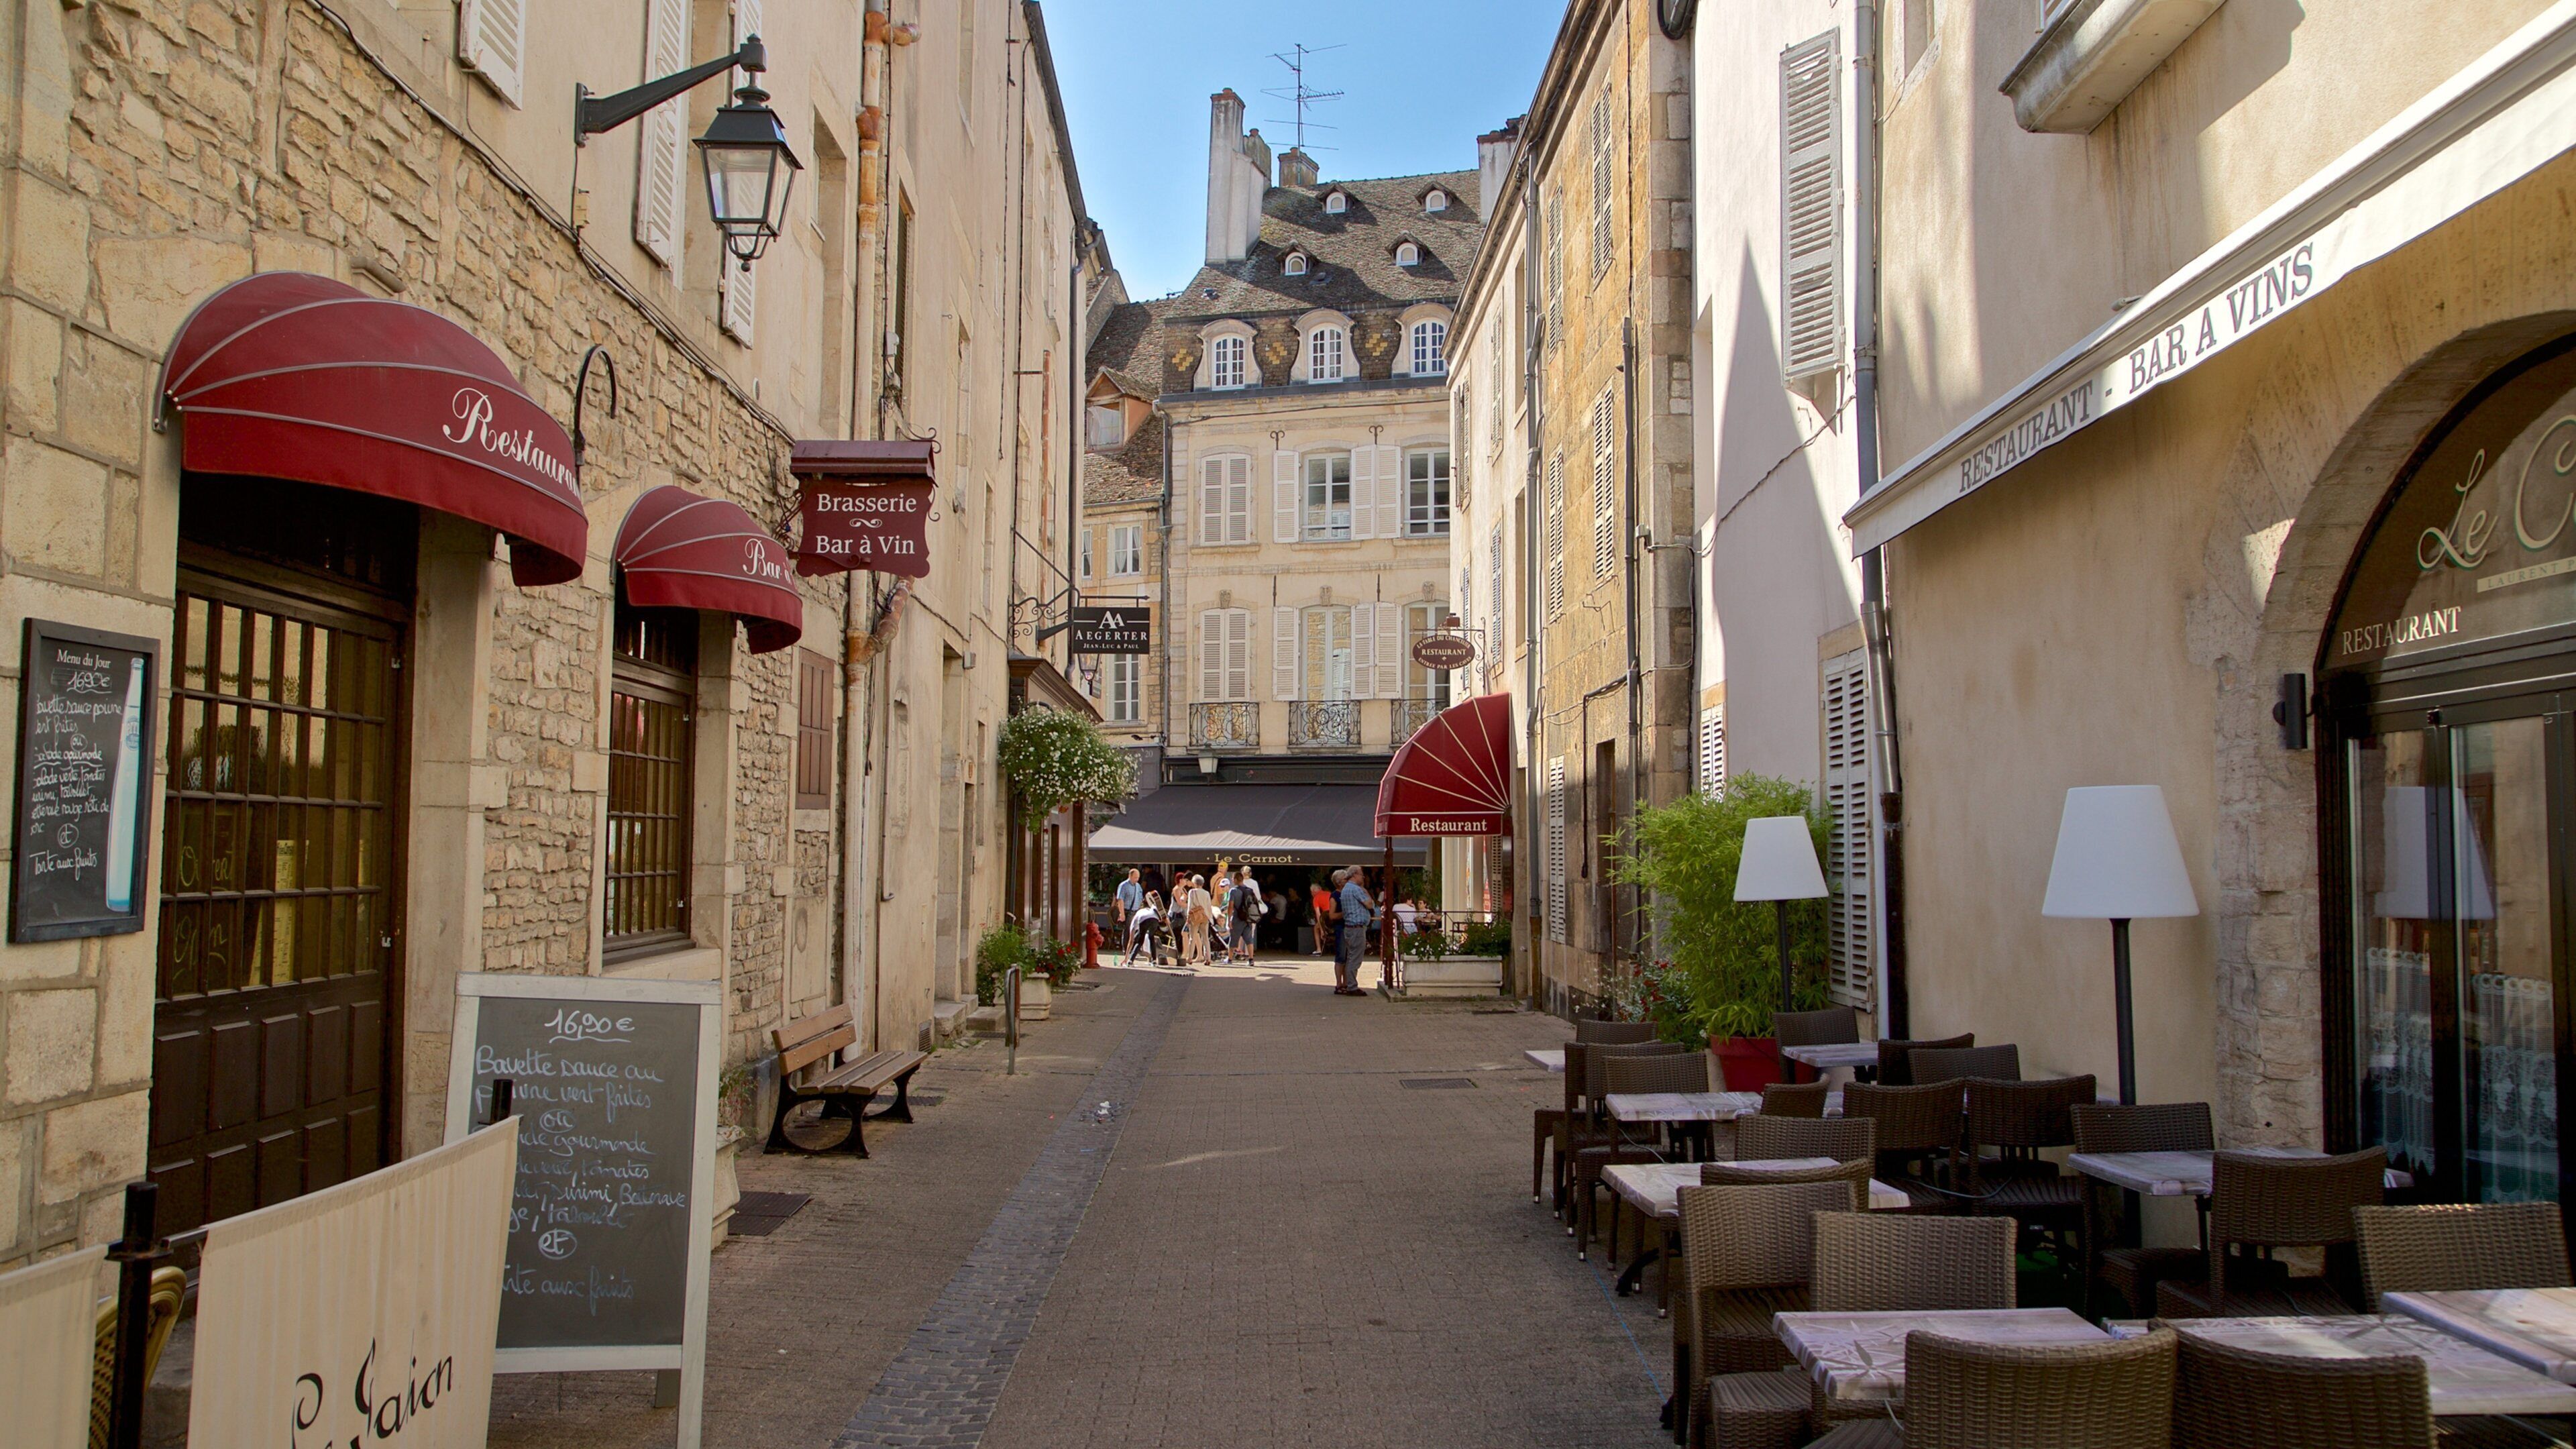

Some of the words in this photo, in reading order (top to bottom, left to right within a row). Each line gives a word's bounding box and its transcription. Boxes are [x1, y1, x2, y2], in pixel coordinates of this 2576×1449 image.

[1960, 380, 2093, 493] RESTAURANT
[2129, 325, 2187, 394] BAR
[2196, 307, 2216, 356] A
[2227, 242, 2314, 334] VINS
[816, 493, 916, 513] Brasserie
[2418, 449, 2498, 571] Le
[816, 536, 853, 554] Bar
[859, 535, 871, 554] à
[878, 535, 915, 554] Vin
[743, 538, 781, 579] Bar
[2488, 563, 2559, 588] LAURENT
[1075, 630, 1148, 640] AEGERTER
[2342, 606, 2461, 655] RESTAURANT
[57, 649, 80, 664] Menu
[83, 653, 93, 666] du
[94, 655, 111, 670] Jour
[72, 737, 83, 746] ou
[101, 798, 109, 812] de
[1410, 818, 1487, 832] Restaurant
[30, 850, 58, 875] Tarte
[57, 857, 74, 868] aux
[74, 848, 97, 881] fruits
[1214, 853, 1232, 863] Le
[1238, 853, 1292, 863] Carnot
[476, 1045, 557, 1075] Bavette
[625, 1064, 664, 1083] au
[560, 1083, 604, 1103] vert
[606, 1081, 651, 1123] frites
[543, 1112, 572, 1128] ou
[550, 1131, 655, 1156] gourmande
[582, 1159, 649, 1179] tomates
[541, 1229, 569, 1255] et
[541, 1279, 585, 1297] aux
[588, 1265, 635, 1316] fruits
